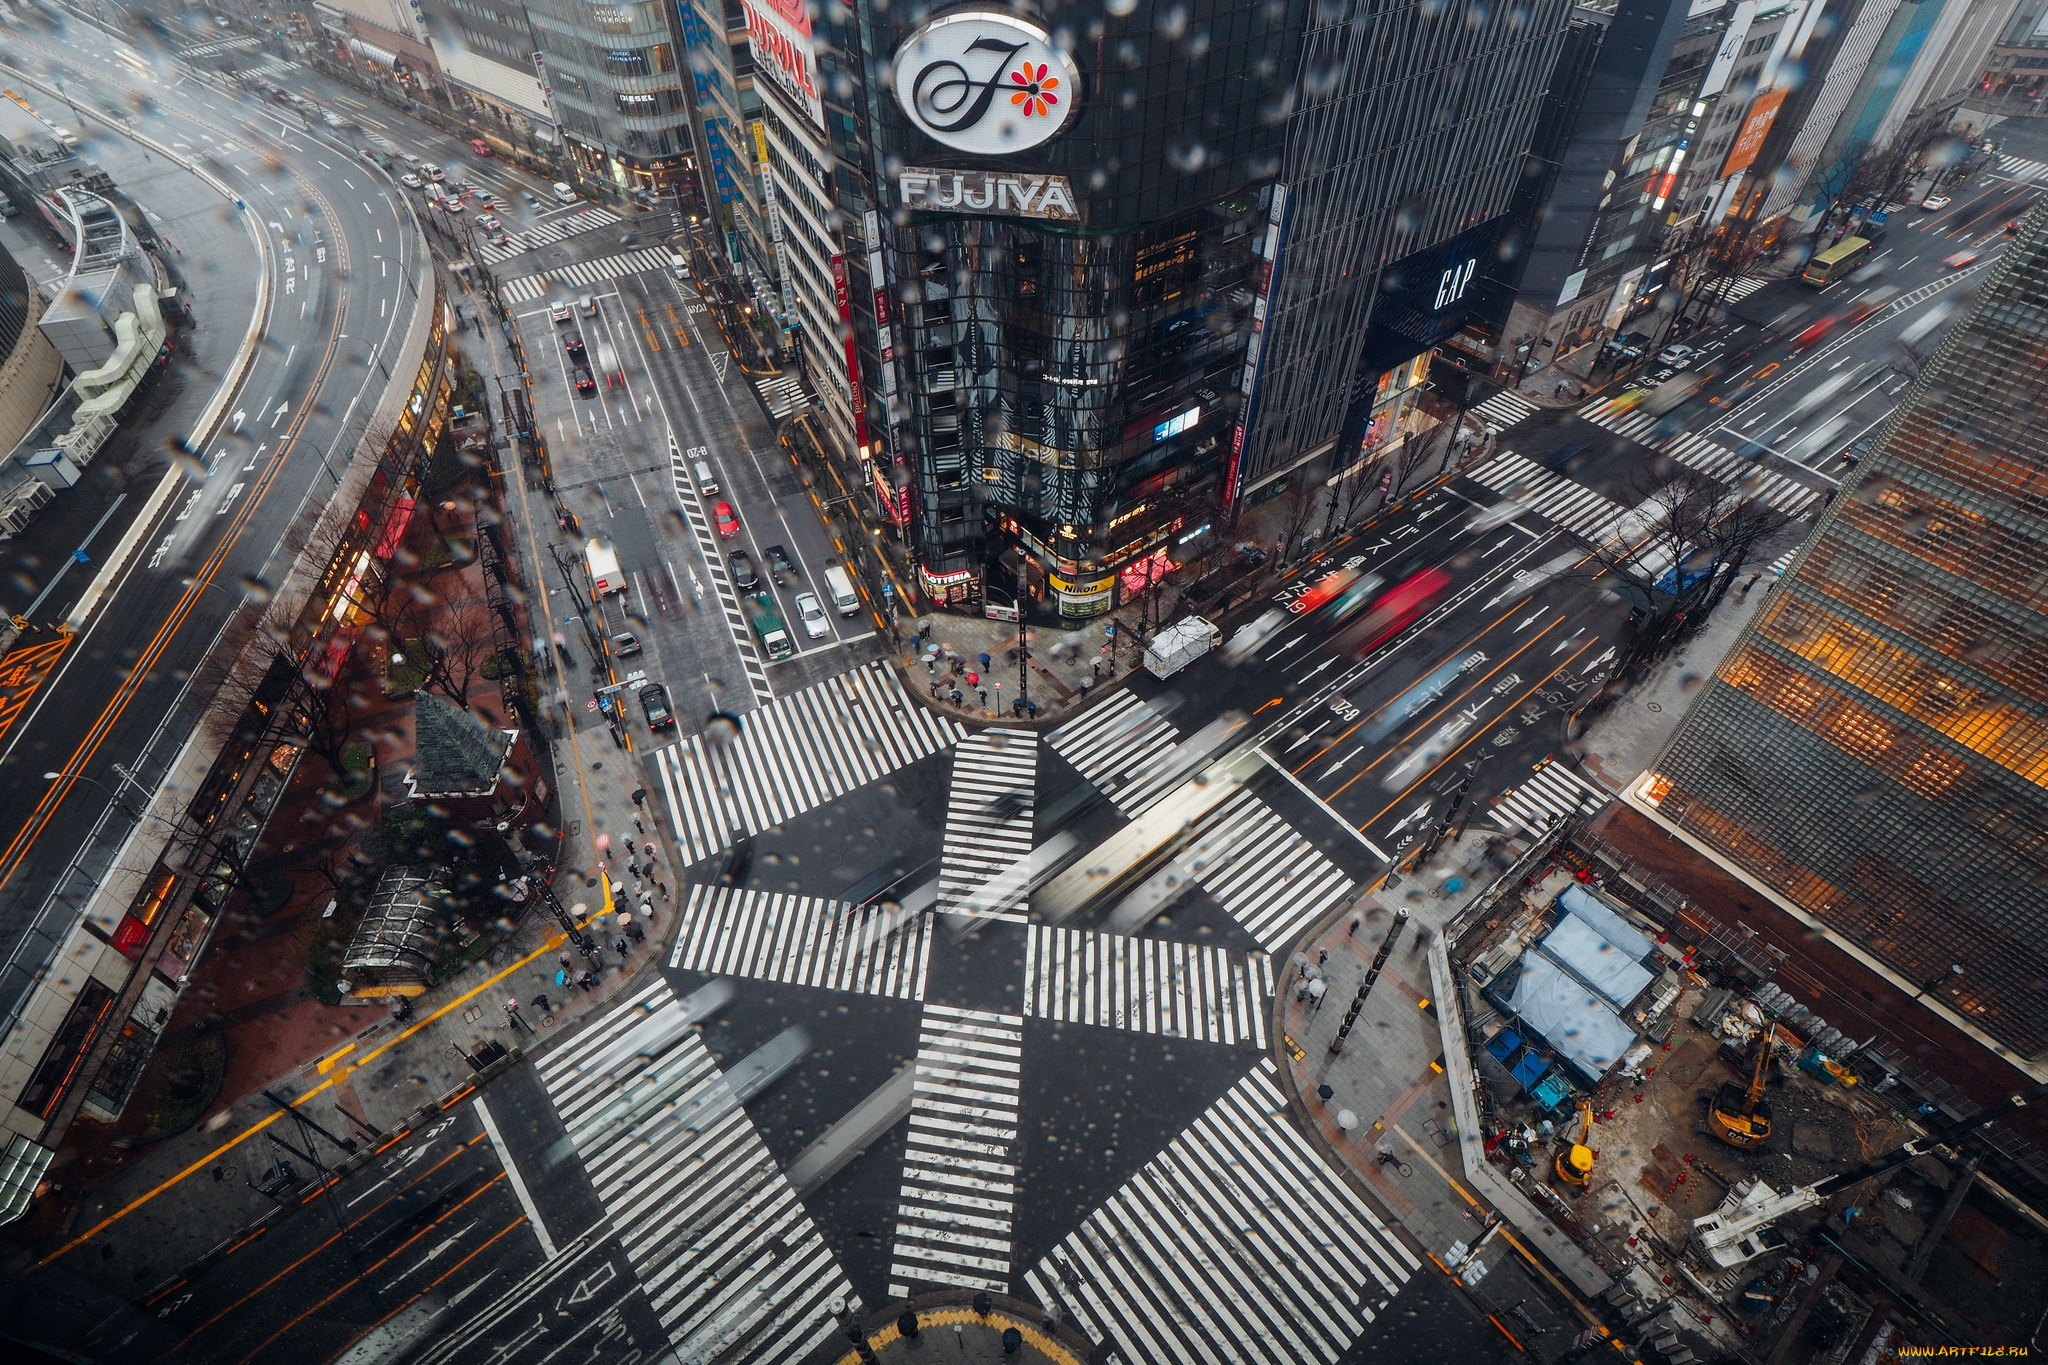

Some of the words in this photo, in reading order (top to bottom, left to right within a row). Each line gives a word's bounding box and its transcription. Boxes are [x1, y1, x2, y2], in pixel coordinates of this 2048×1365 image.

[620, 94, 655, 102] DIESEL
[899, 172, 1079, 214] FUJIYA
[1434, 258, 1476, 310] GAP
[925, 571, 972, 585] LOTTERIA
[1064, 583, 1098, 593] Nikon
[1728, 1131, 1750, 1144] CAT
